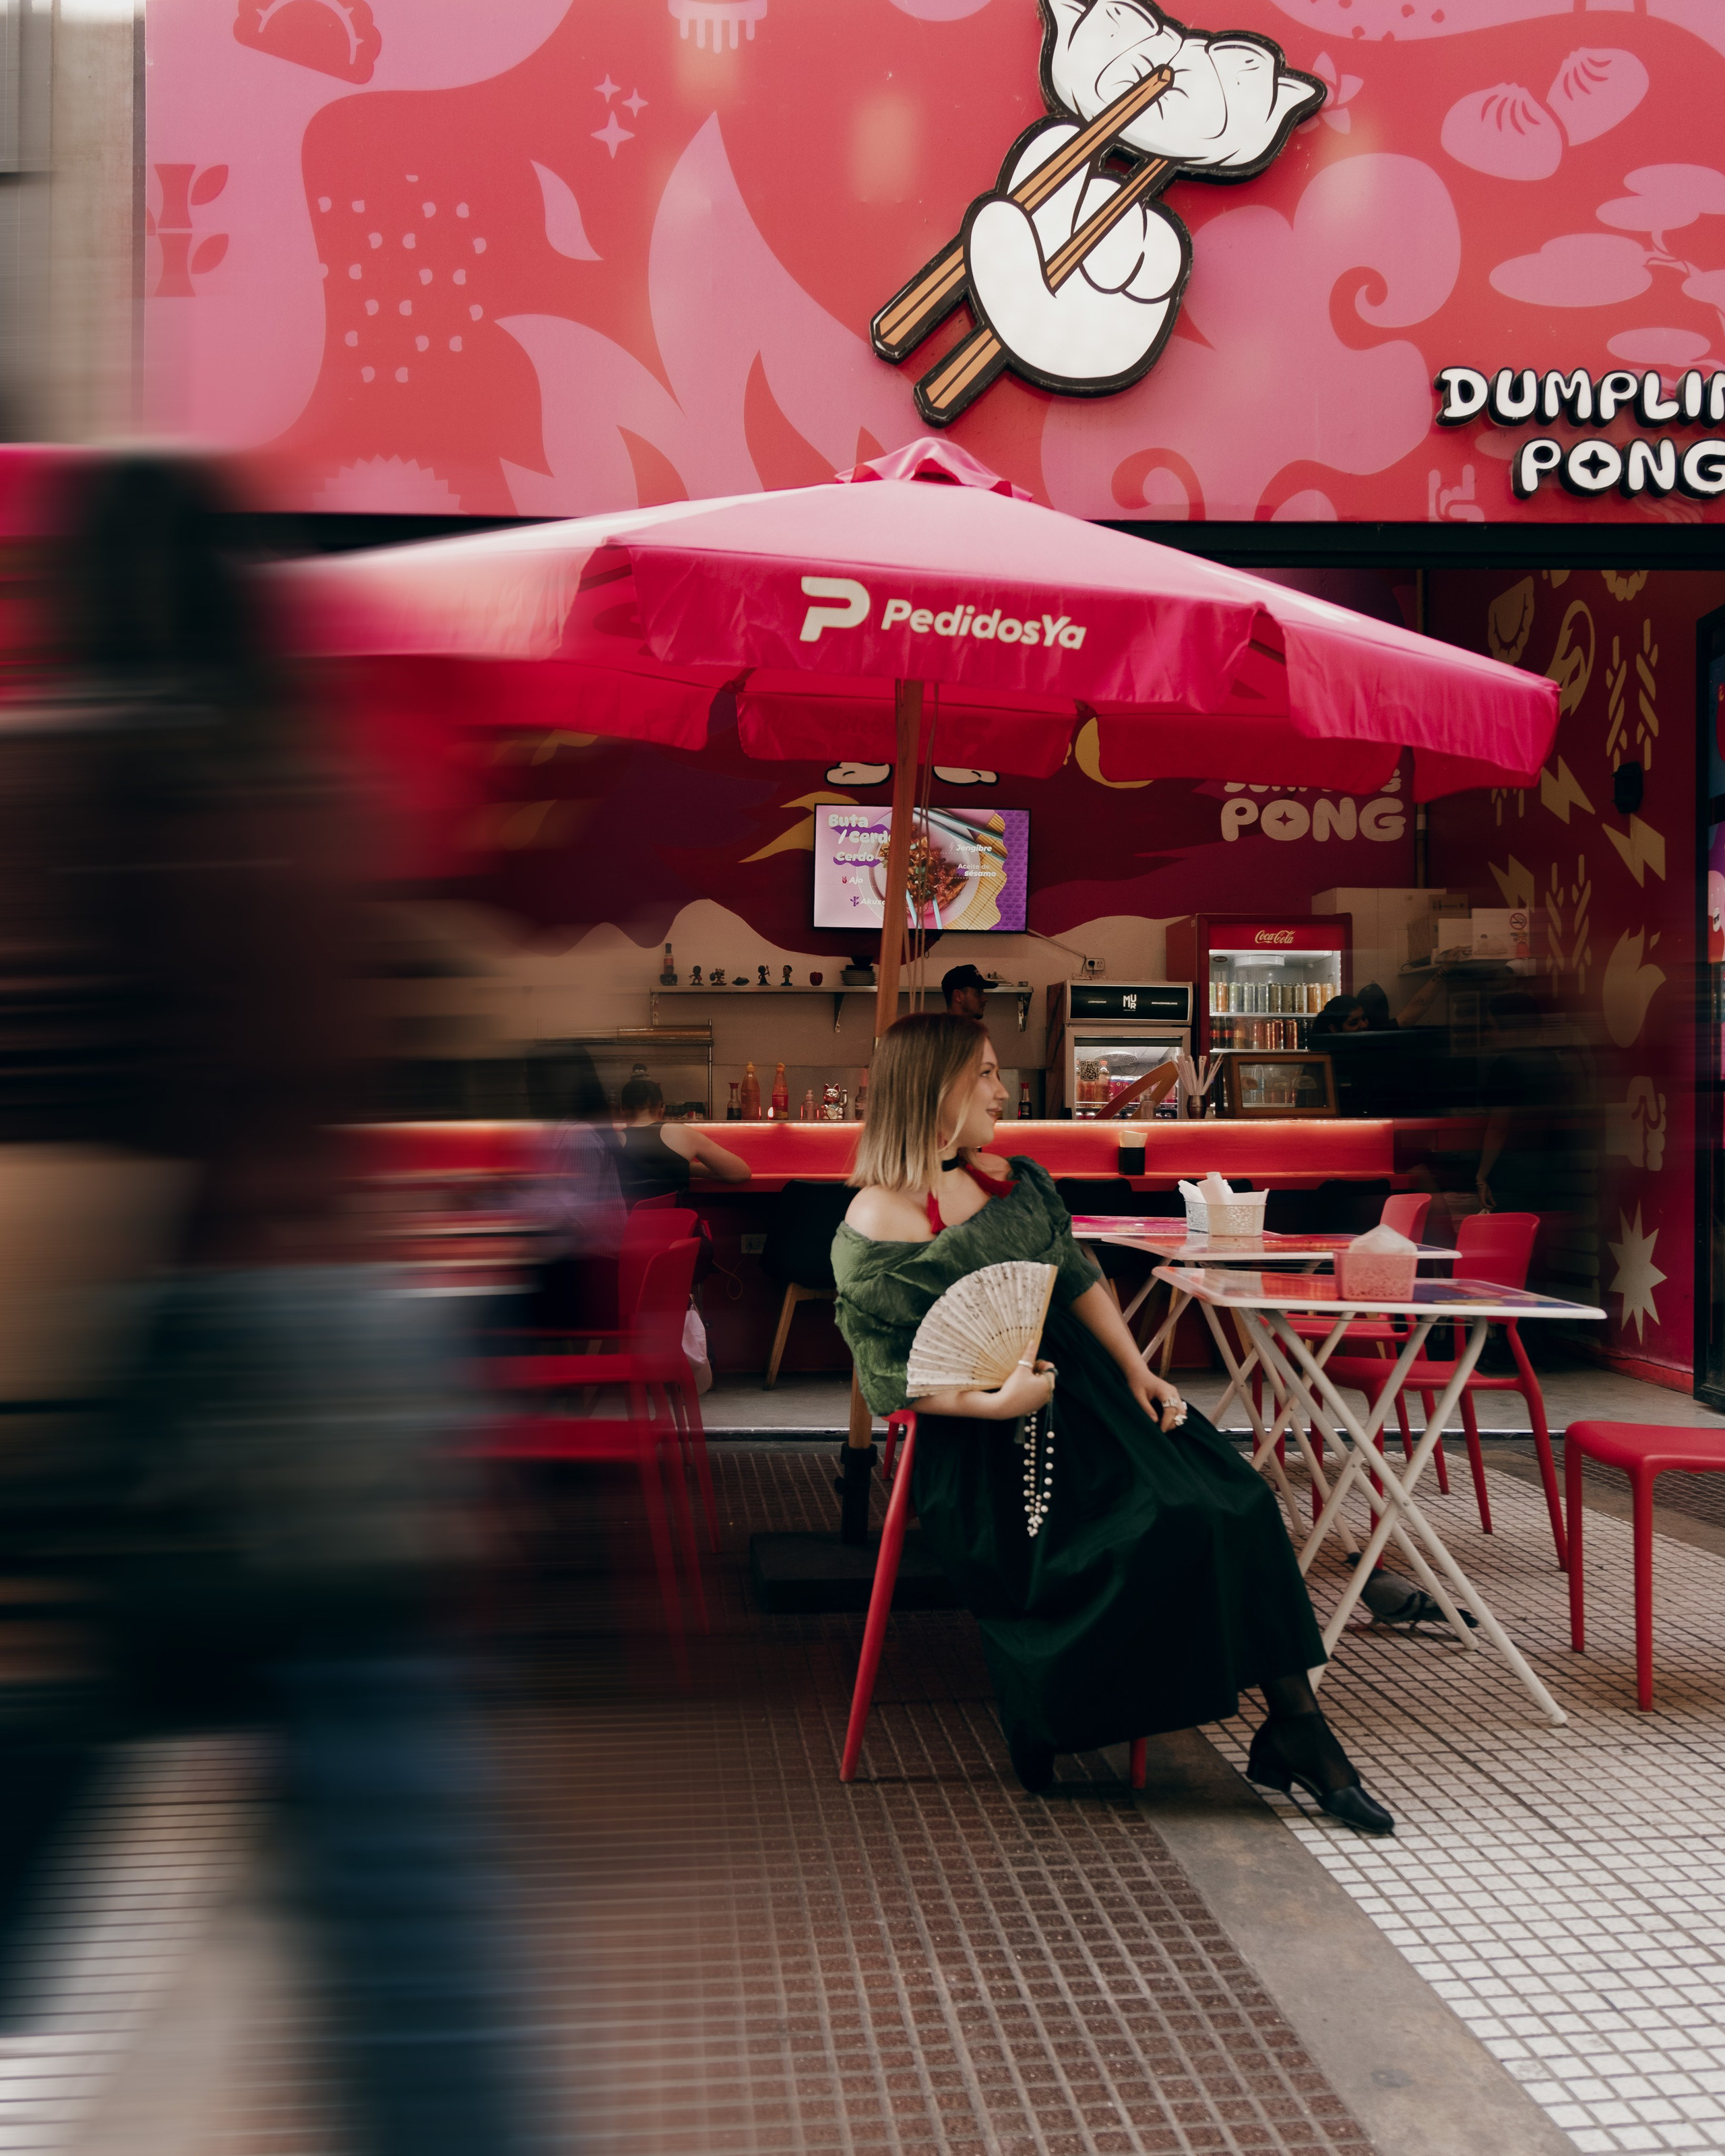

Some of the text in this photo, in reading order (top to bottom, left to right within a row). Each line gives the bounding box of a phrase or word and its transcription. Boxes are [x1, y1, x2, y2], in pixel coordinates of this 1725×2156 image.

[1435, 367, 1725, 426] DUMPLI
[1512, 437, 1725, 499] PONG
[881, 598, 1087, 649] PedidosYa
[828, 814, 869, 828] Buta
[1220, 797, 1406, 842] PONG
[849, 830, 891, 844] Cerd
[955, 844, 993, 853] Jengibre
[836, 851, 875, 862] Cerdo
[964, 869, 997, 877] sésamo
[849, 877, 863, 885] Ajo
[1255, 930, 1296, 944] Coca-Cola
